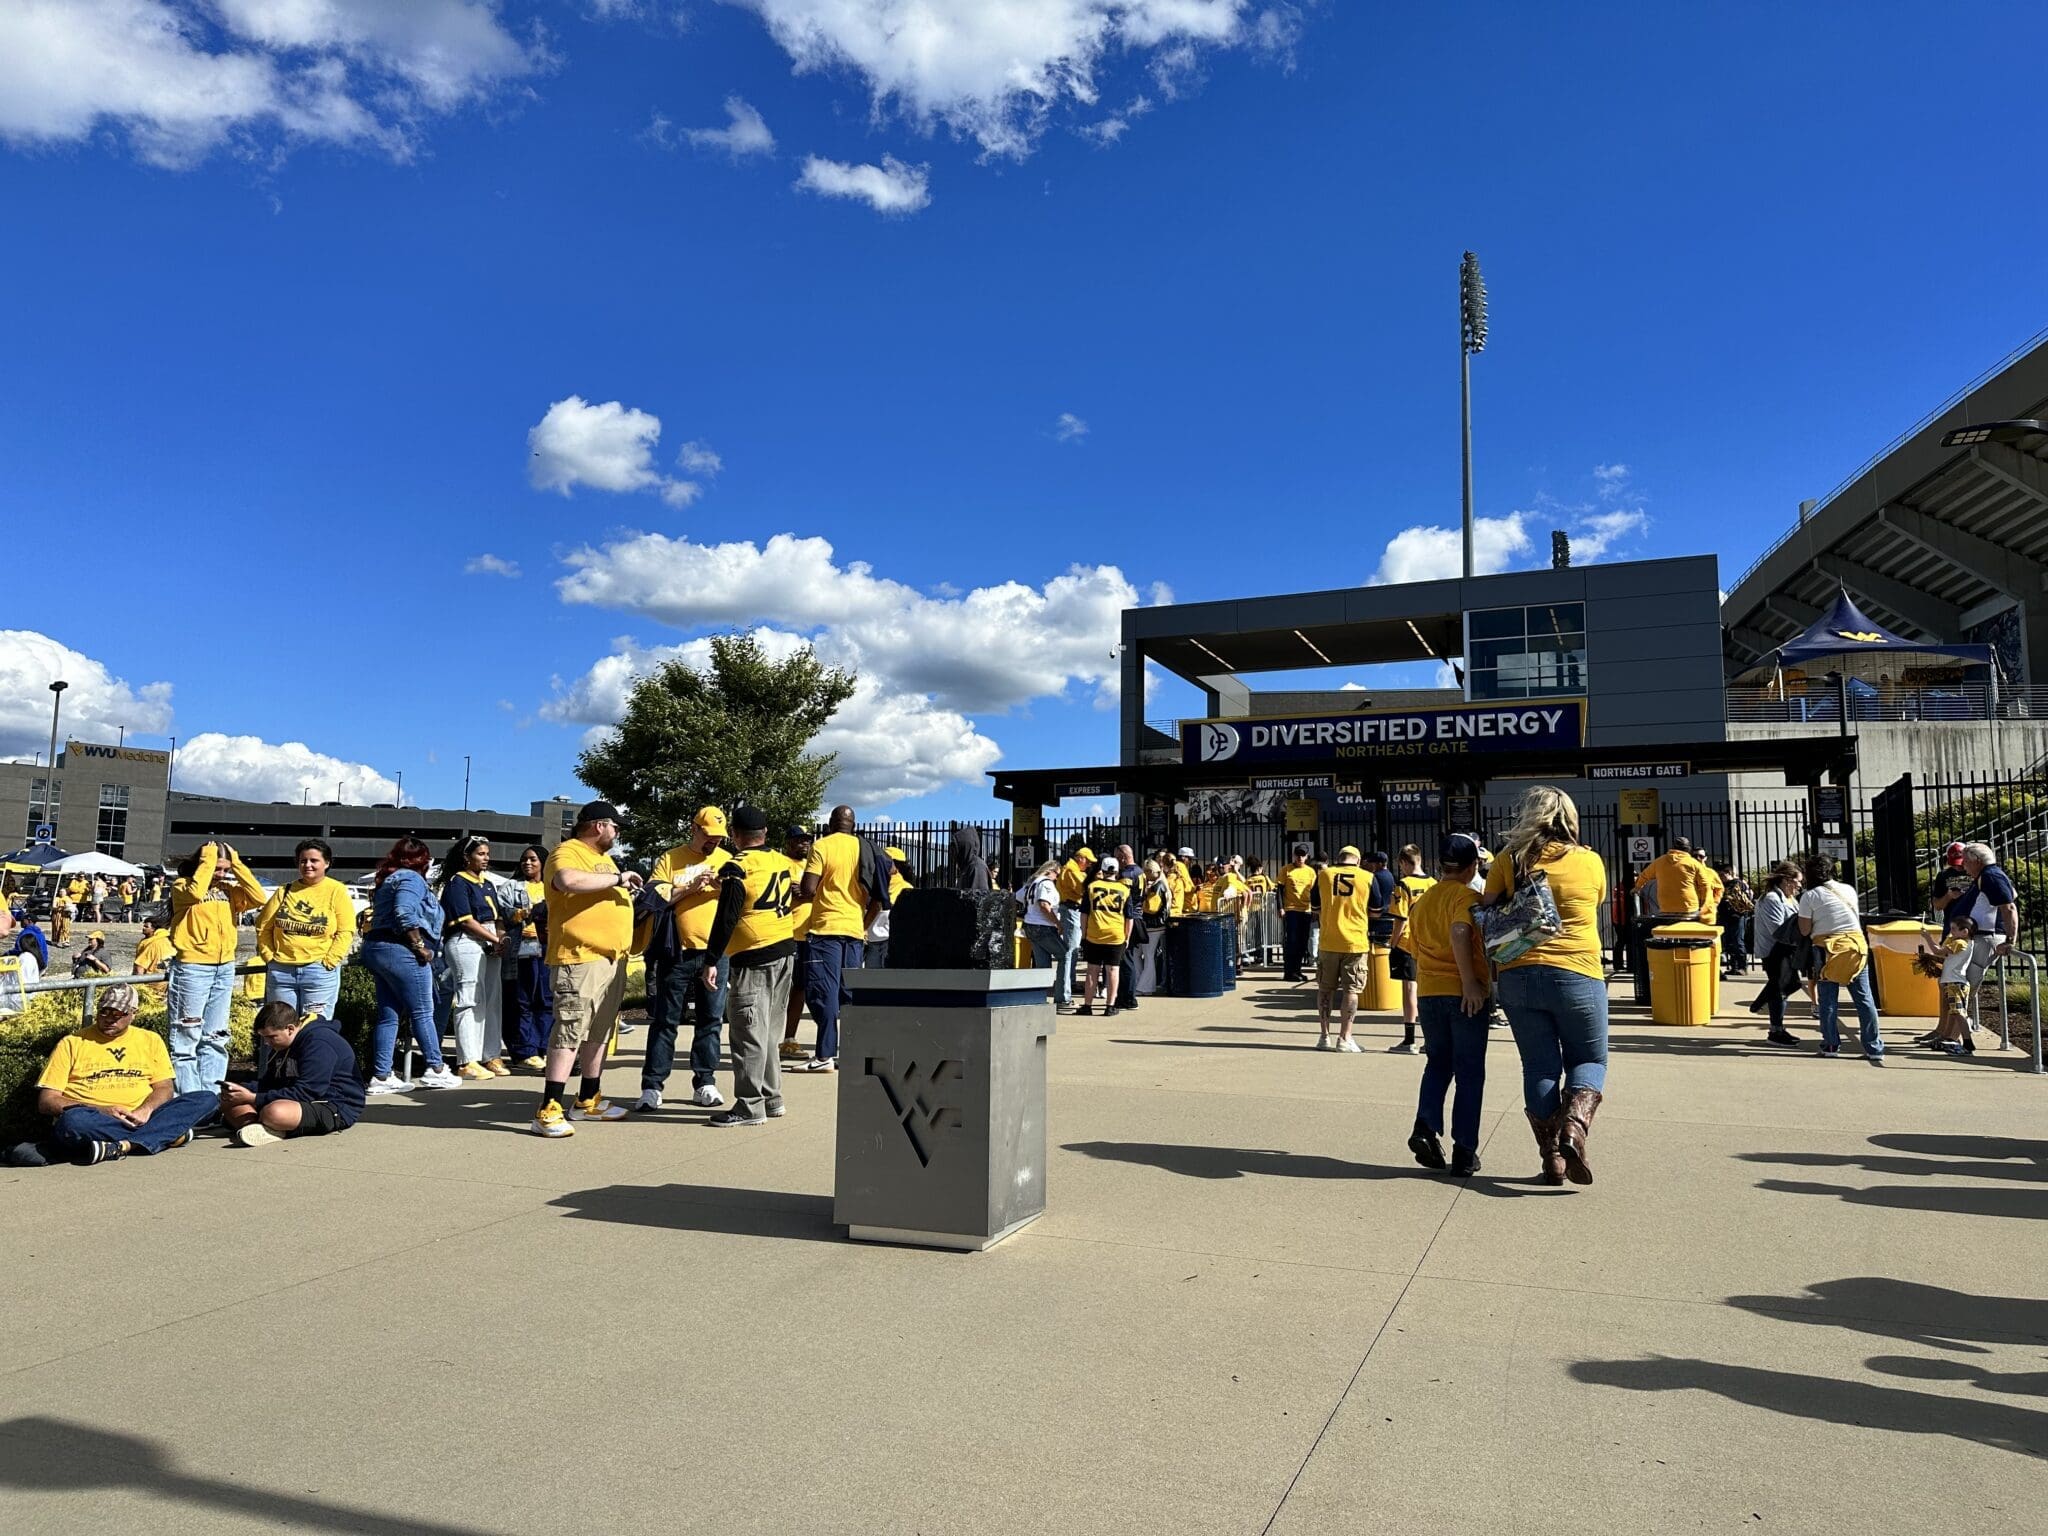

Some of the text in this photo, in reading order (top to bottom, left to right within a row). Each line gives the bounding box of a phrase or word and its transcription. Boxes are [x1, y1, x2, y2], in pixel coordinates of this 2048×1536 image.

[1251, 709, 1564, 747] DIVERSIFIED ENERGY
[1335, 740, 1469, 759] NORTHEAST GATE
[1592, 765, 1682, 778] NORTHEAST GATE
[1069, 785, 1101, 794] EXPRESS
[1255, 777, 1329, 789] NORTHEAST GATE
[752, 868, 792, 919] 42
[1332, 872, 1355, 897] 15
[1091, 885, 1124, 913] 23
